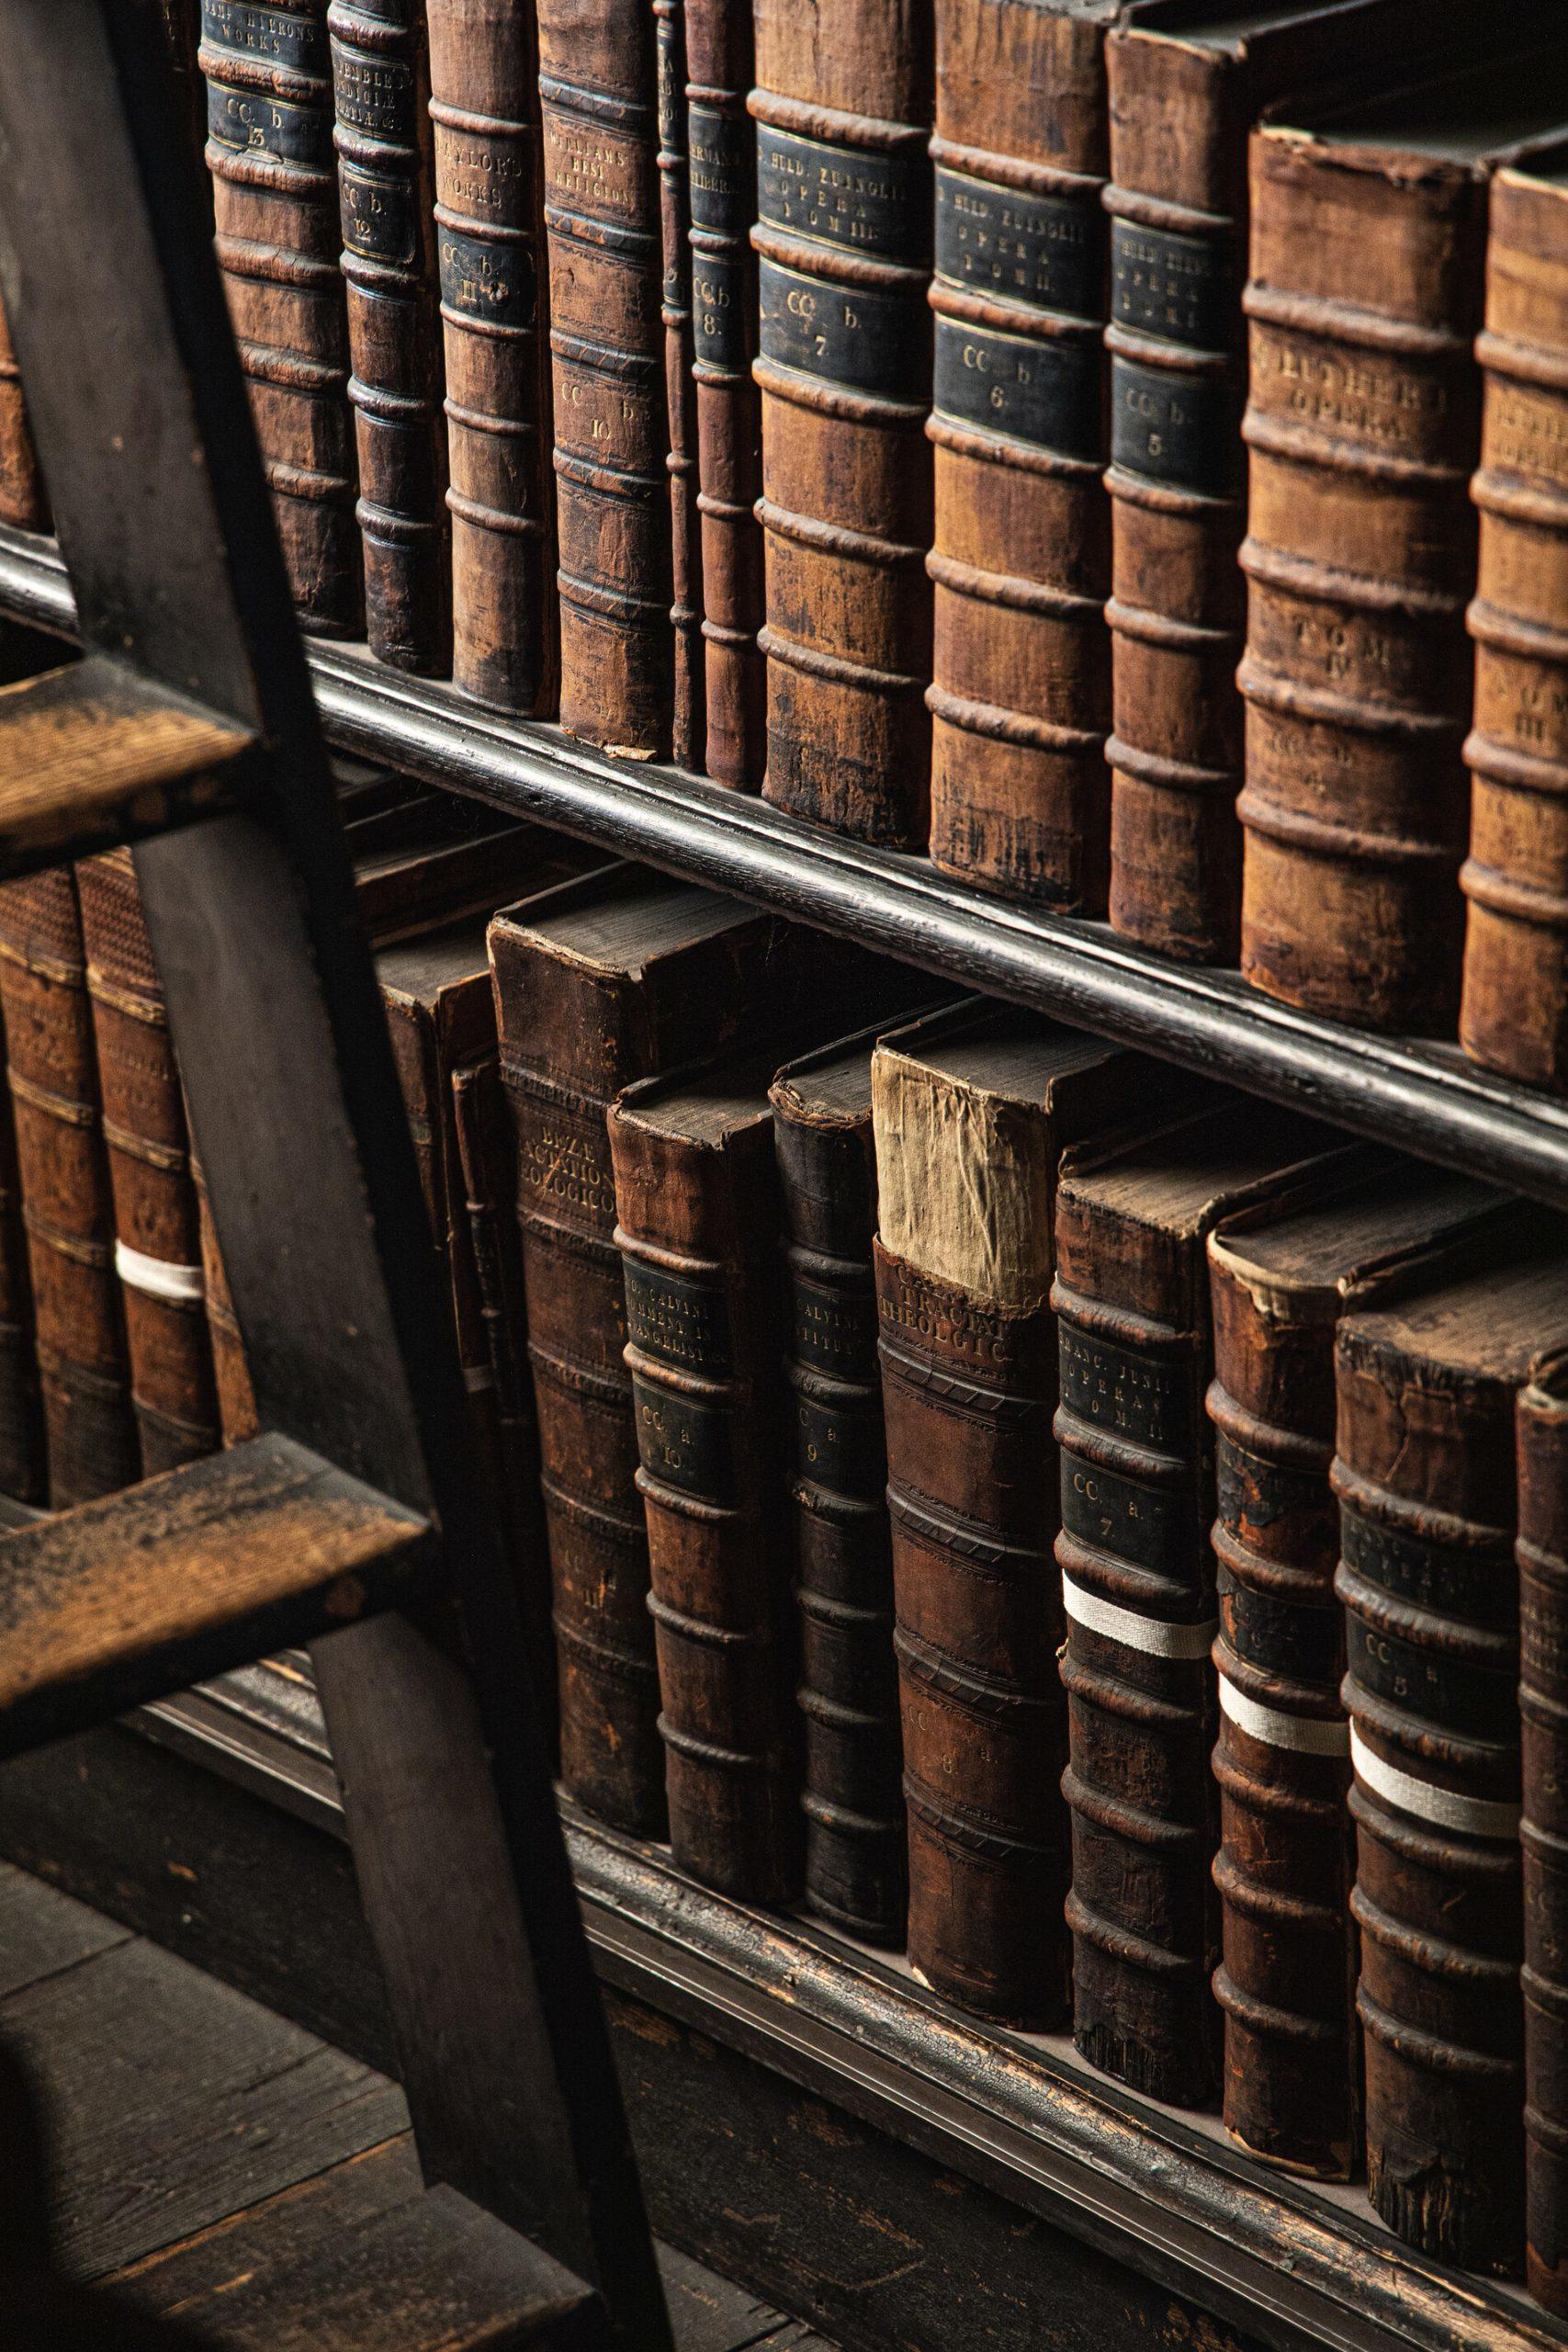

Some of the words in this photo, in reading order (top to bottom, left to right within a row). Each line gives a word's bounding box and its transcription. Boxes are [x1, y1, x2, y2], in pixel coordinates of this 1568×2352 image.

[222, 24, 280, 53] WORKS
[572, 155, 604, 180] BEST
[443, 176, 502, 209] WORKS
[781, 180, 866, 219] OPERA
